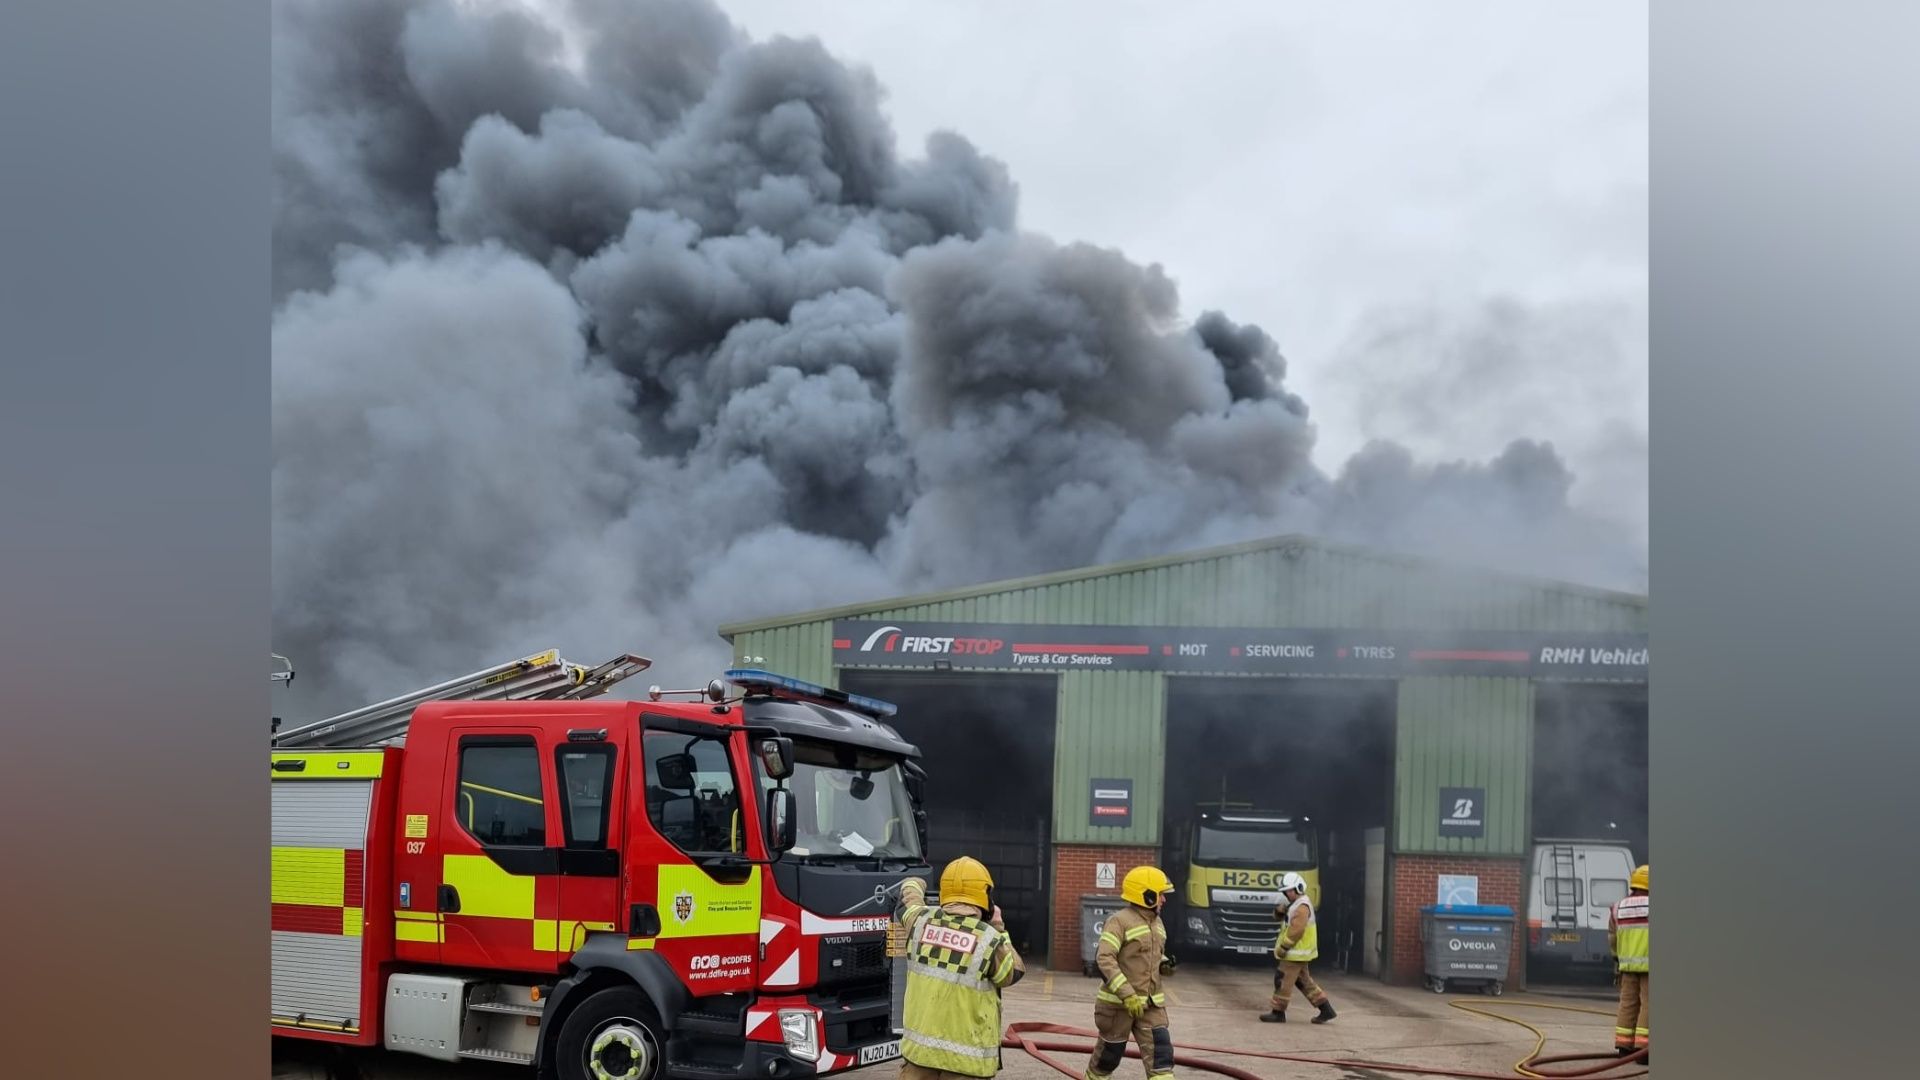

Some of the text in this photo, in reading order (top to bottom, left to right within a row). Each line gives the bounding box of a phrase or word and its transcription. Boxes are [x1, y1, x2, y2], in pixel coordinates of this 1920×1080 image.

[1179, 644, 1208, 656] MOT
[1246, 645, 1314, 657] SERVICING
[1353, 646, 1395, 659] TYRES
[1540, 647, 1649, 665] RMH Vehicl
[1012, 653, 1113, 665] Tyres & Car Services
[406, 841, 425, 854] 037
[852, 918, 888, 932] FIRE & RE
[825, 936, 852, 944] VOLVO
[926, 928, 970, 948] BA ECO
[1462, 942, 1496, 950] VEOLIA
[689, 966, 751, 980] www.ddfire.gov.uk
[863, 1042, 900, 1062] NJ20 AZN
